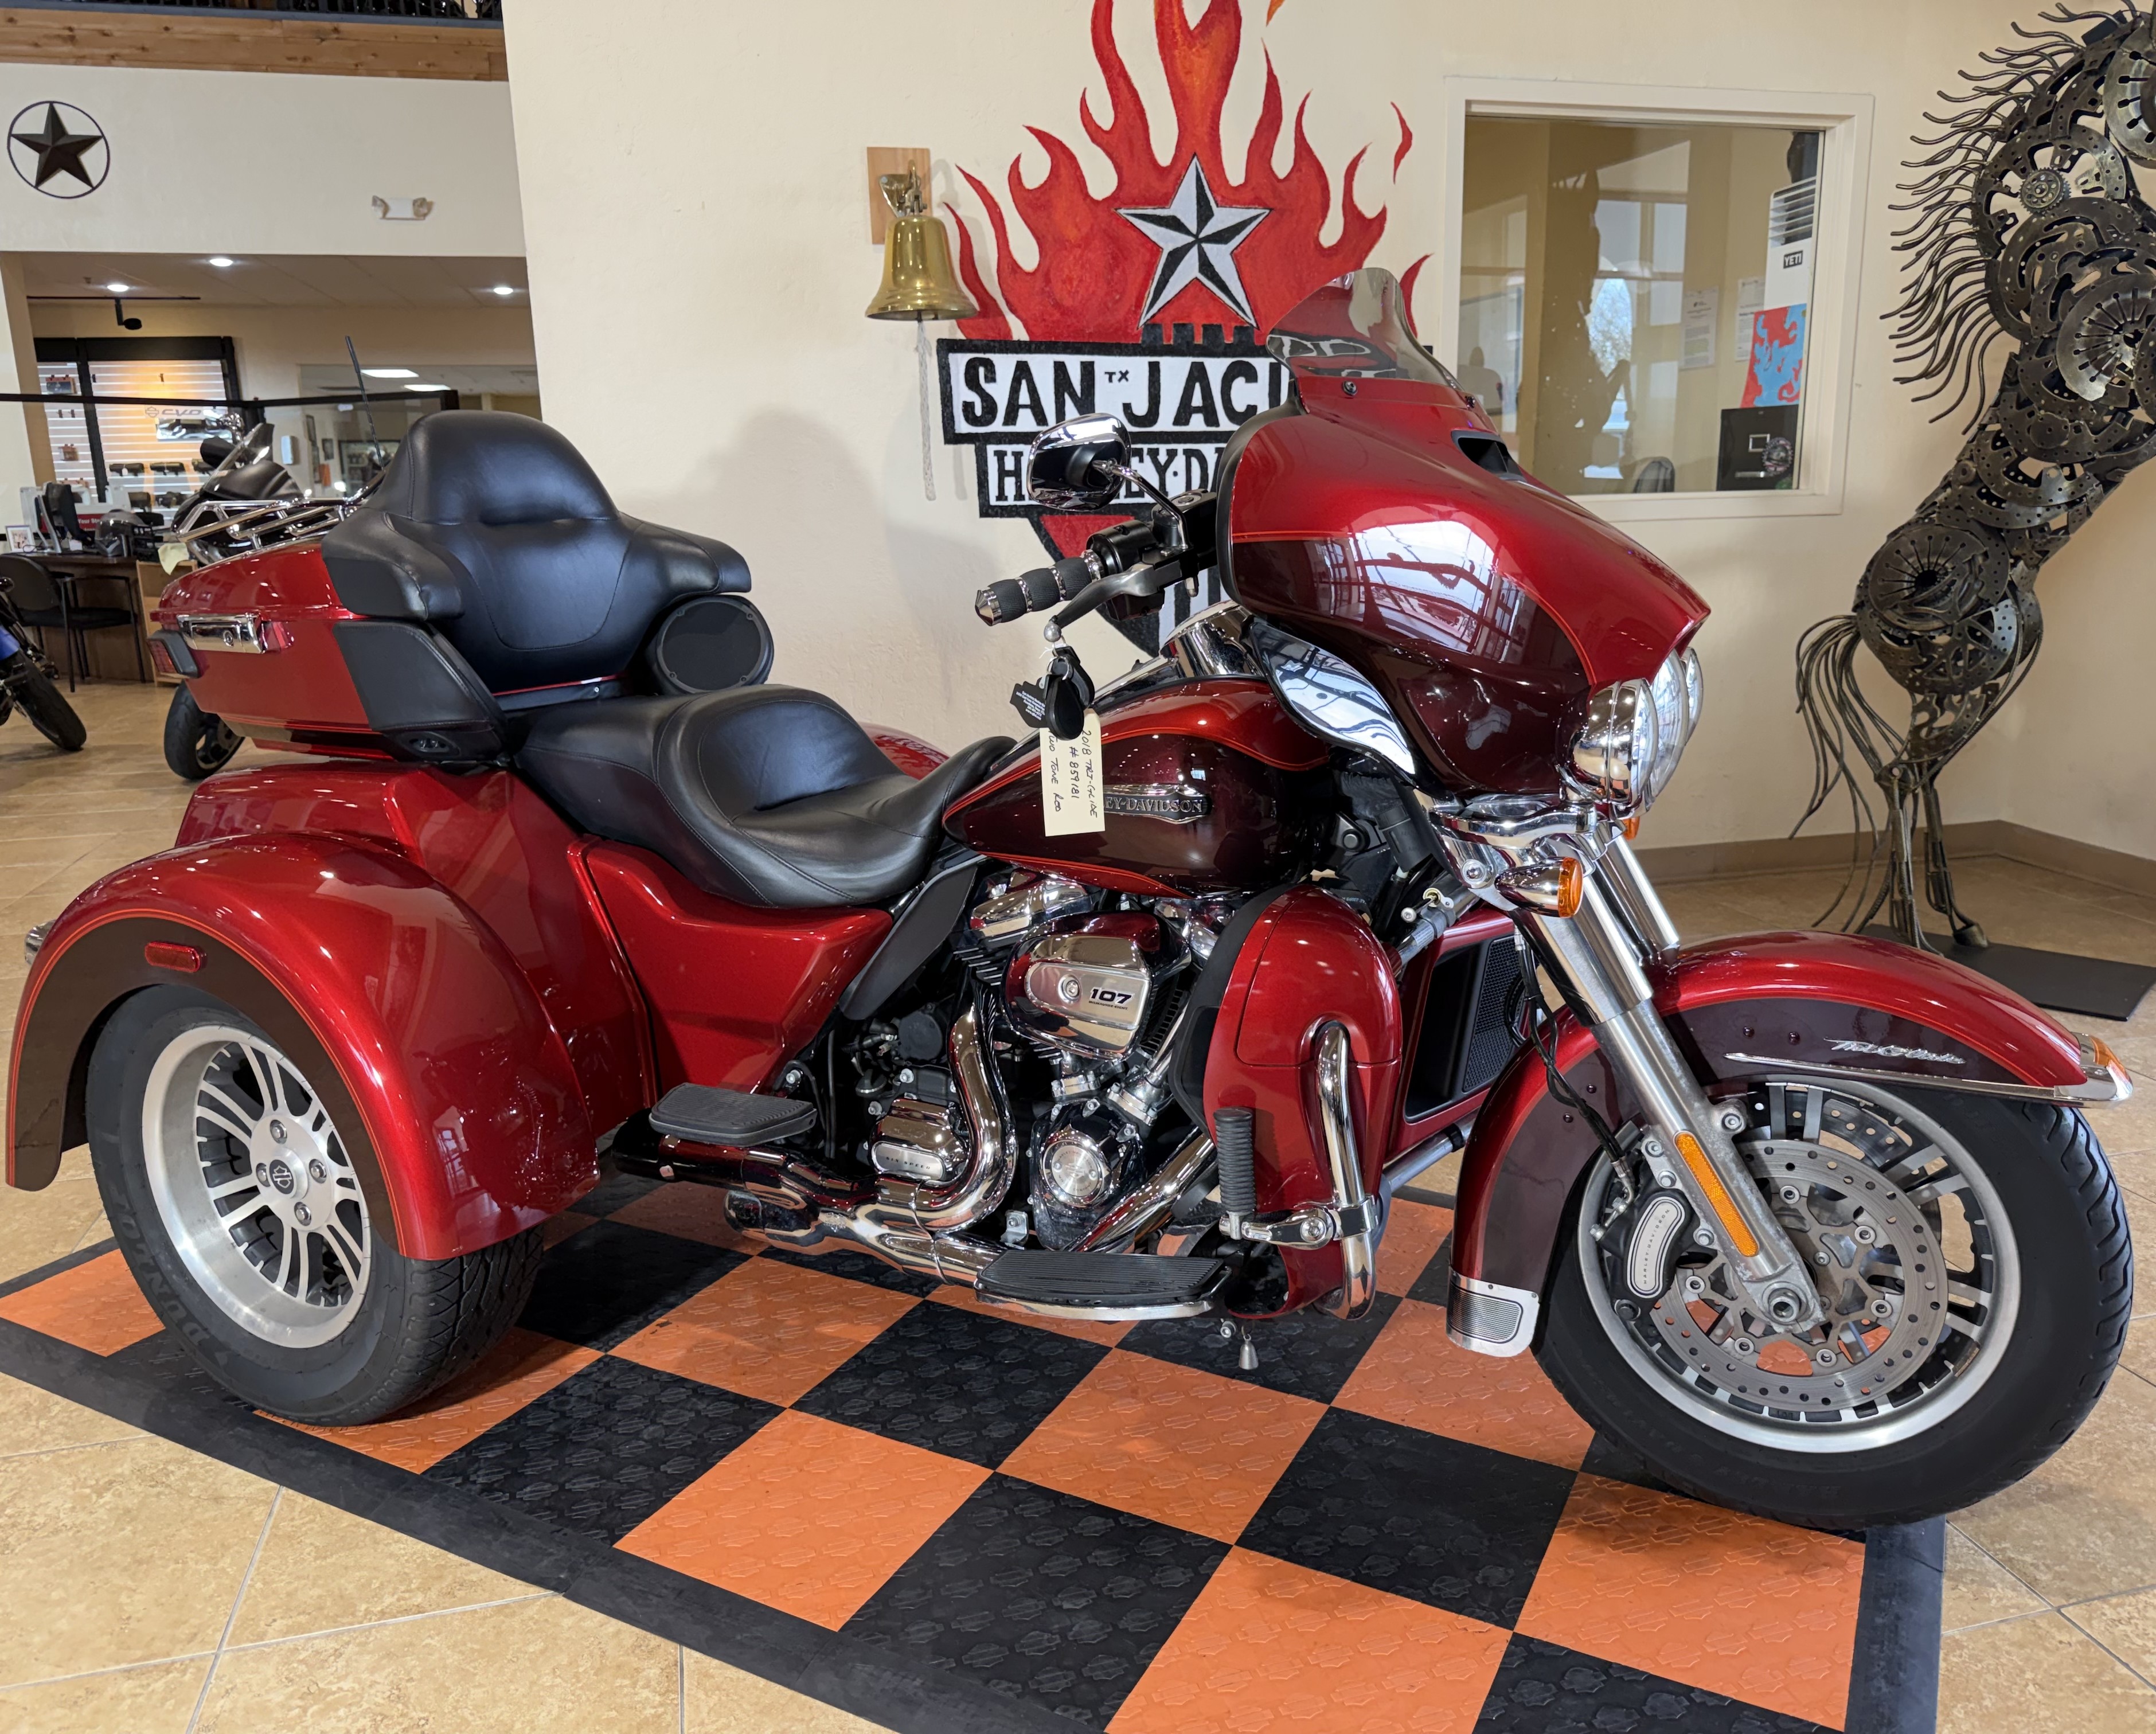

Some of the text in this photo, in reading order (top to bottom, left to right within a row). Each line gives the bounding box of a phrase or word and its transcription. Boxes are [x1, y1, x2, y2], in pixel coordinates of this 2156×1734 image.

[1784, 252, 1802, 267] YETI
[962, 357, 1282, 428] SAN TX JACI
[1081, 730, 1092, 755] 2018
[1050, 757, 1059, 784] TONE
[1069, 761, 1080, 799] 859181
[1105, 796, 1203, 813] EY-DAVIDSON
[1091, 988, 1132, 1004] 107
